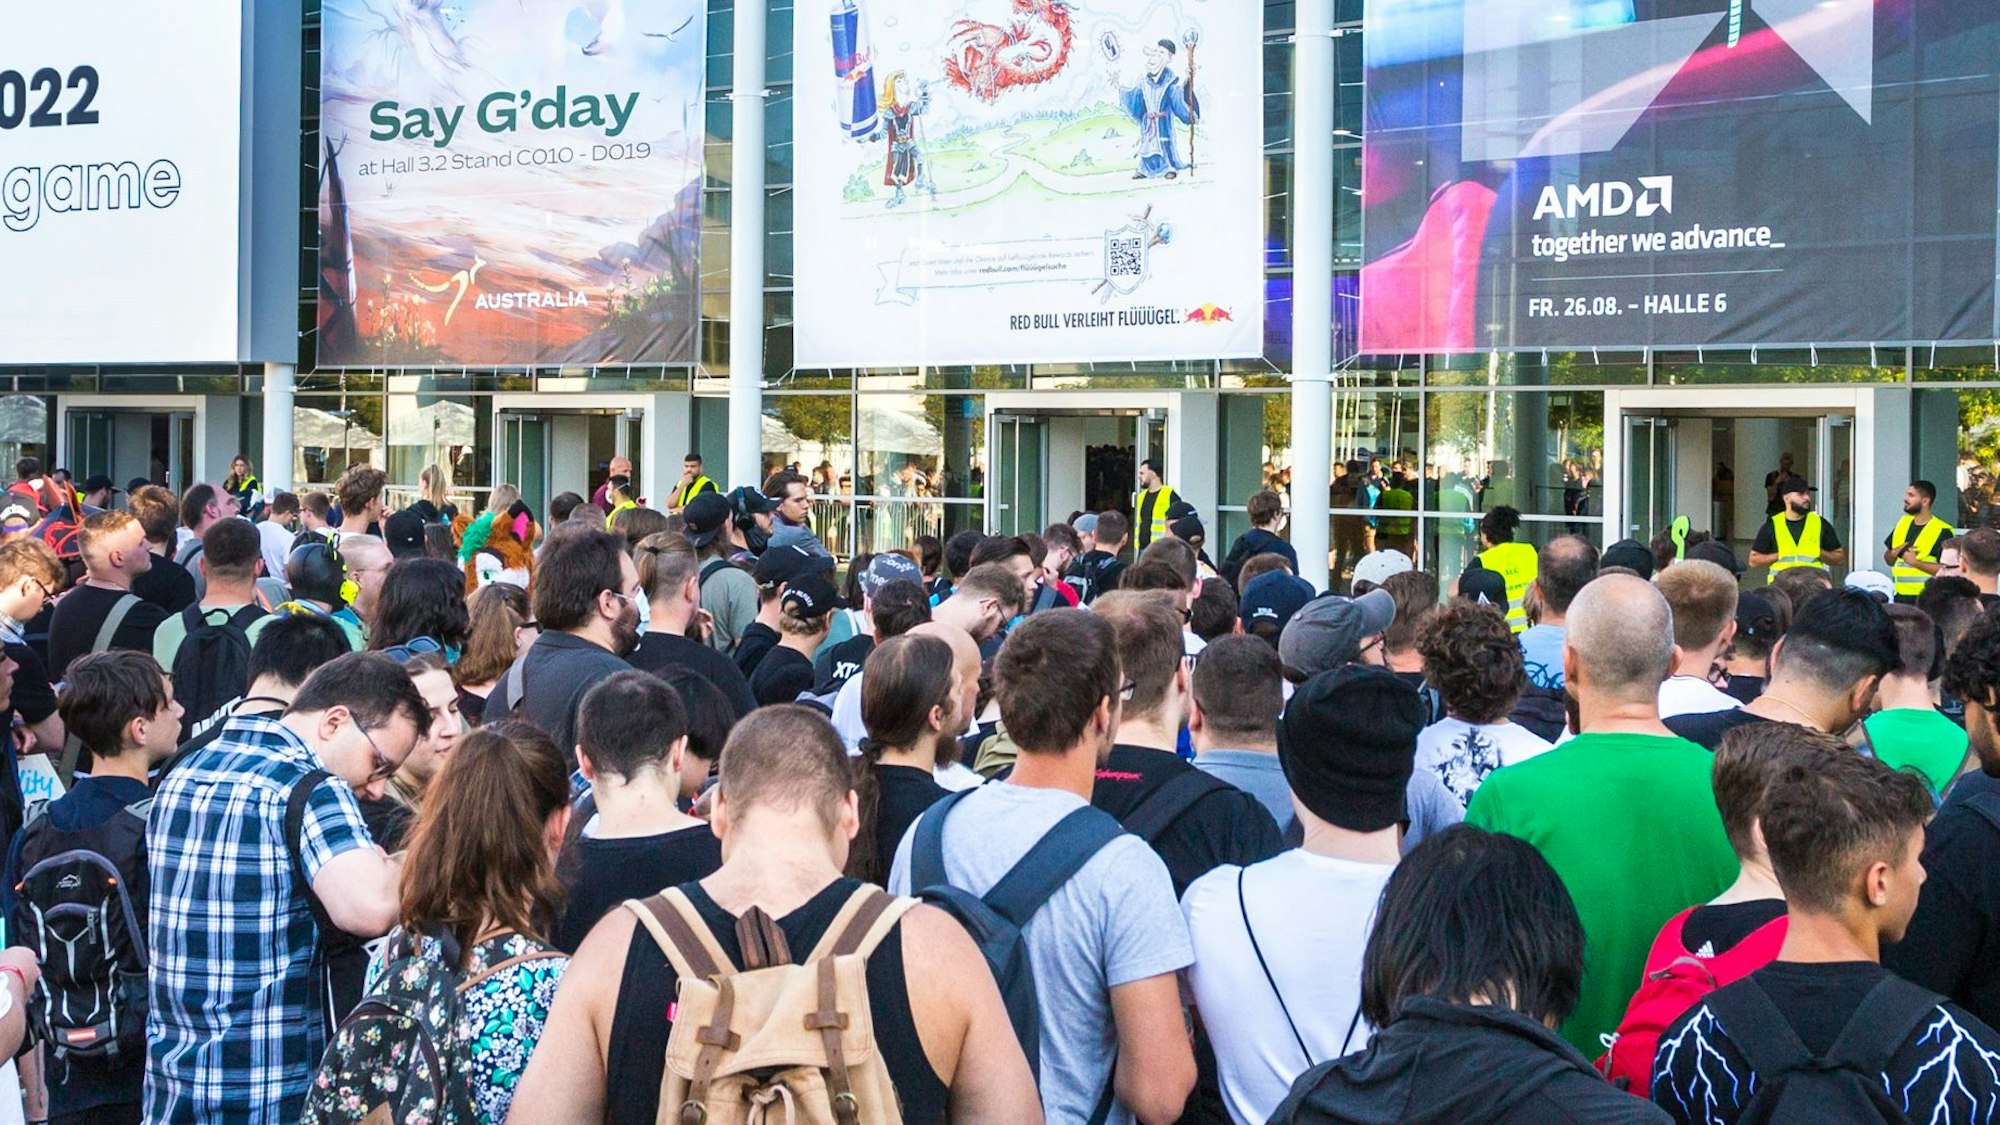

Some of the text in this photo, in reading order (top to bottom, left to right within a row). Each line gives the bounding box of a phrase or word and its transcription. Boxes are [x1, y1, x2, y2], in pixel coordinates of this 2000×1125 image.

[0, 65, 99, 130] 022
[369, 85, 640, 148] Say G'day
[359, 160, 376, 176] at
[382, 153, 414, 173] Hall
[418, 154, 447, 172] 3.2
[451, 146, 512, 170] Stand
[2, 159, 181, 232] game
[1532, 181, 1633, 220] AMD
[1531, 223, 1786, 262] together we advance_
[475, 291, 588, 309] AUSTRALIA
[1529, 299, 1559, 316] FR.
[1564, 297, 1623, 316] 26.08.
[1644, 294, 1709, 314] HALLE
[1714, 293, 1727, 312] 6
[1010, 315, 1031, 330] RED
[1034, 313, 1059, 329] BULL
[1063, 311, 1115, 327] VERLEIHT
